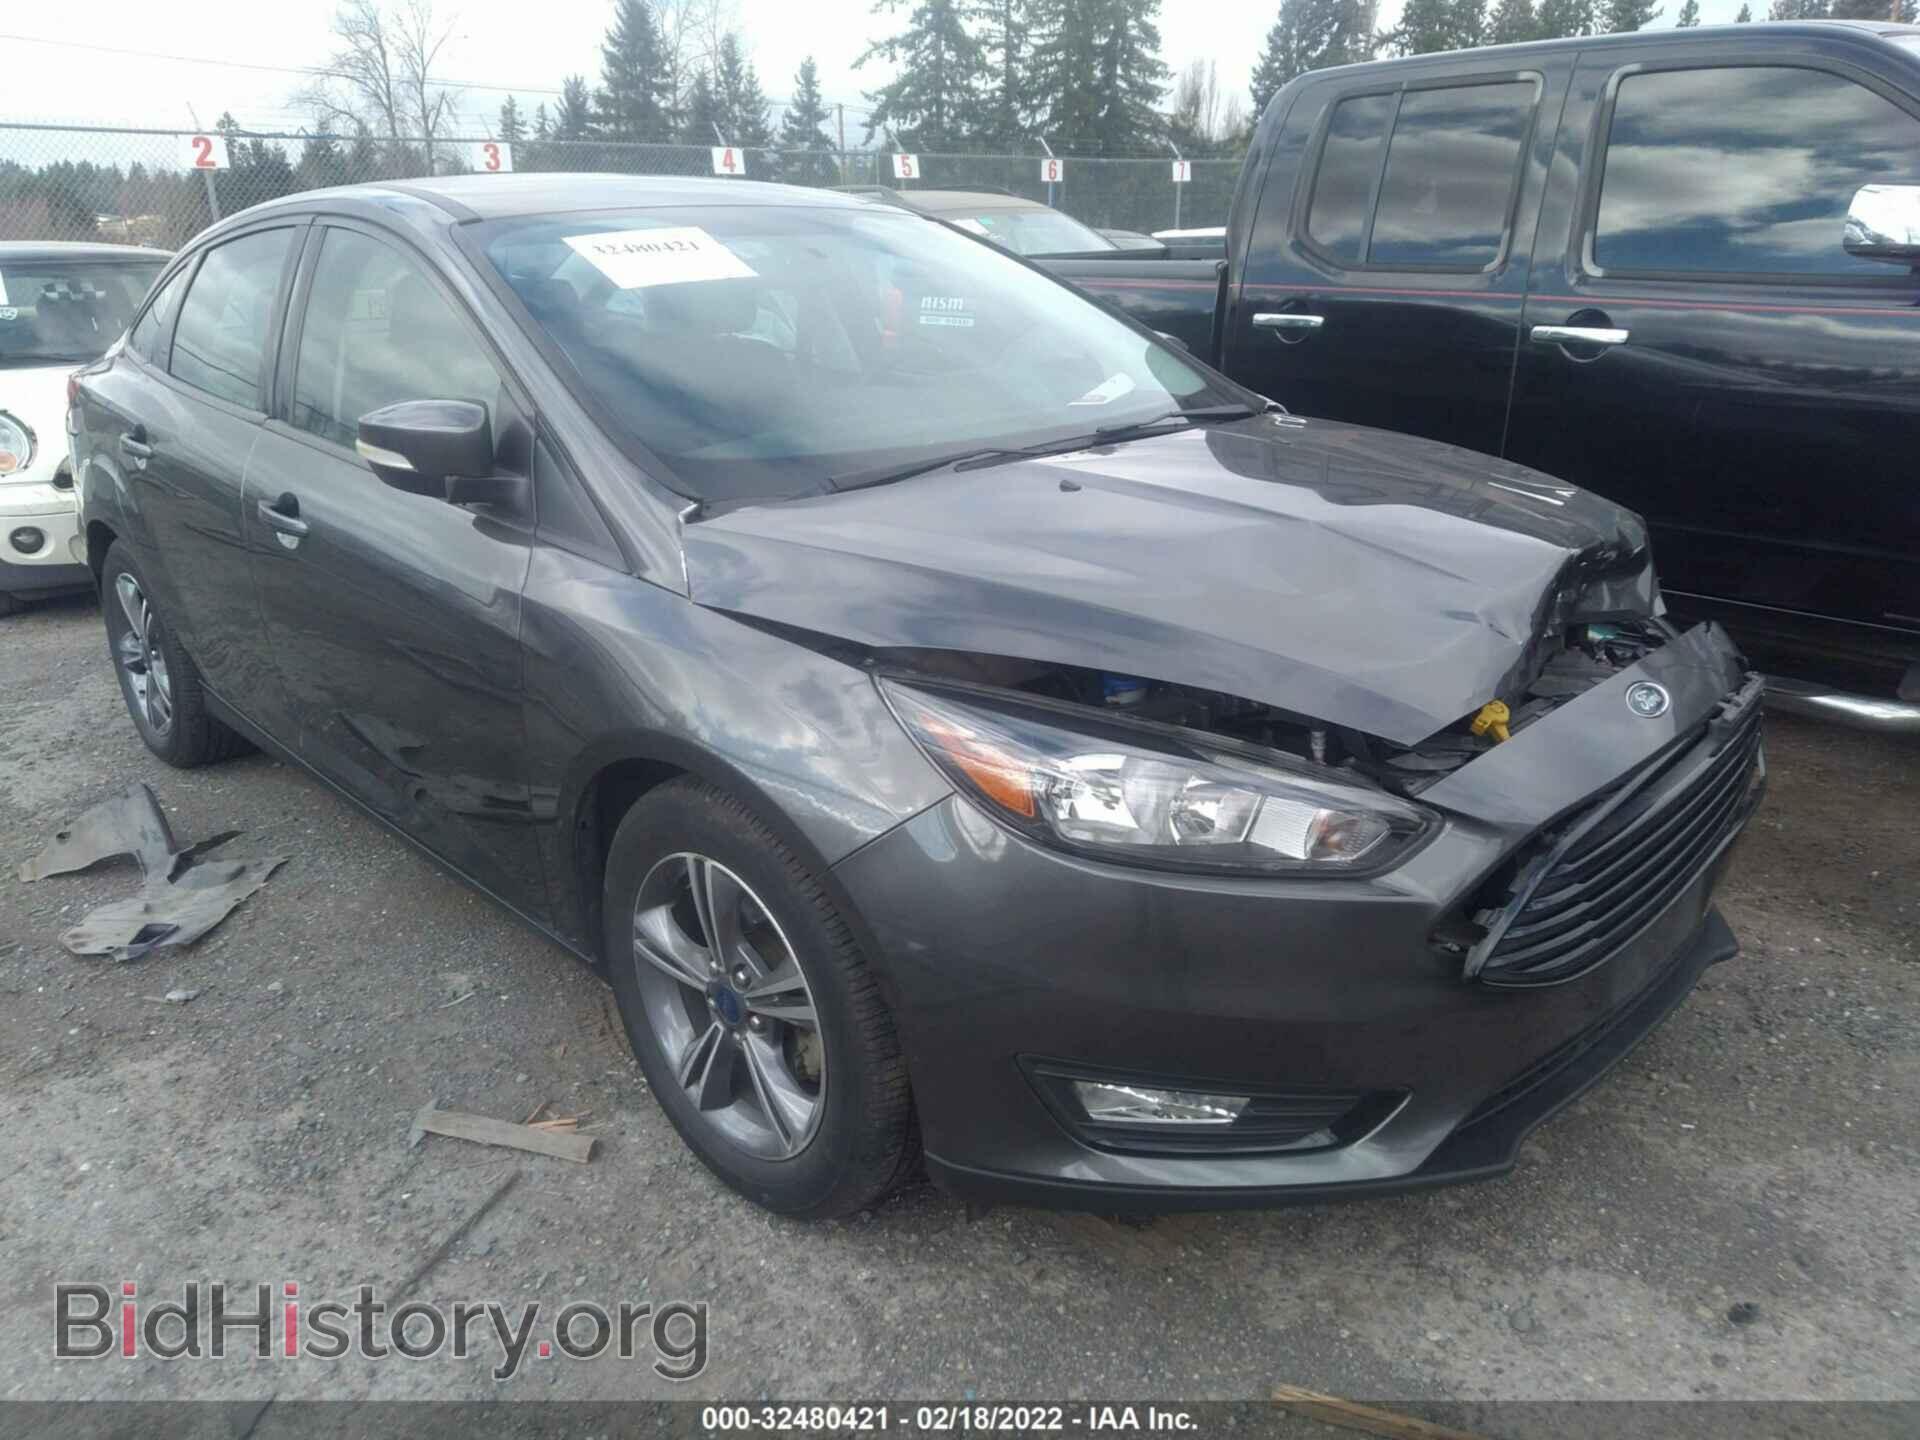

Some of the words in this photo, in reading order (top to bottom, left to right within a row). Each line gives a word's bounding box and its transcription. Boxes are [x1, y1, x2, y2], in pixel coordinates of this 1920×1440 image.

[192, 136, 216, 168] 2
[484, 143, 501, 171] 3
[722, 148, 737, 173] 4
[900, 155, 913, 177] 5
[1048, 160, 1057, 180] 6
[1178, 160, 1187, 180] 7
